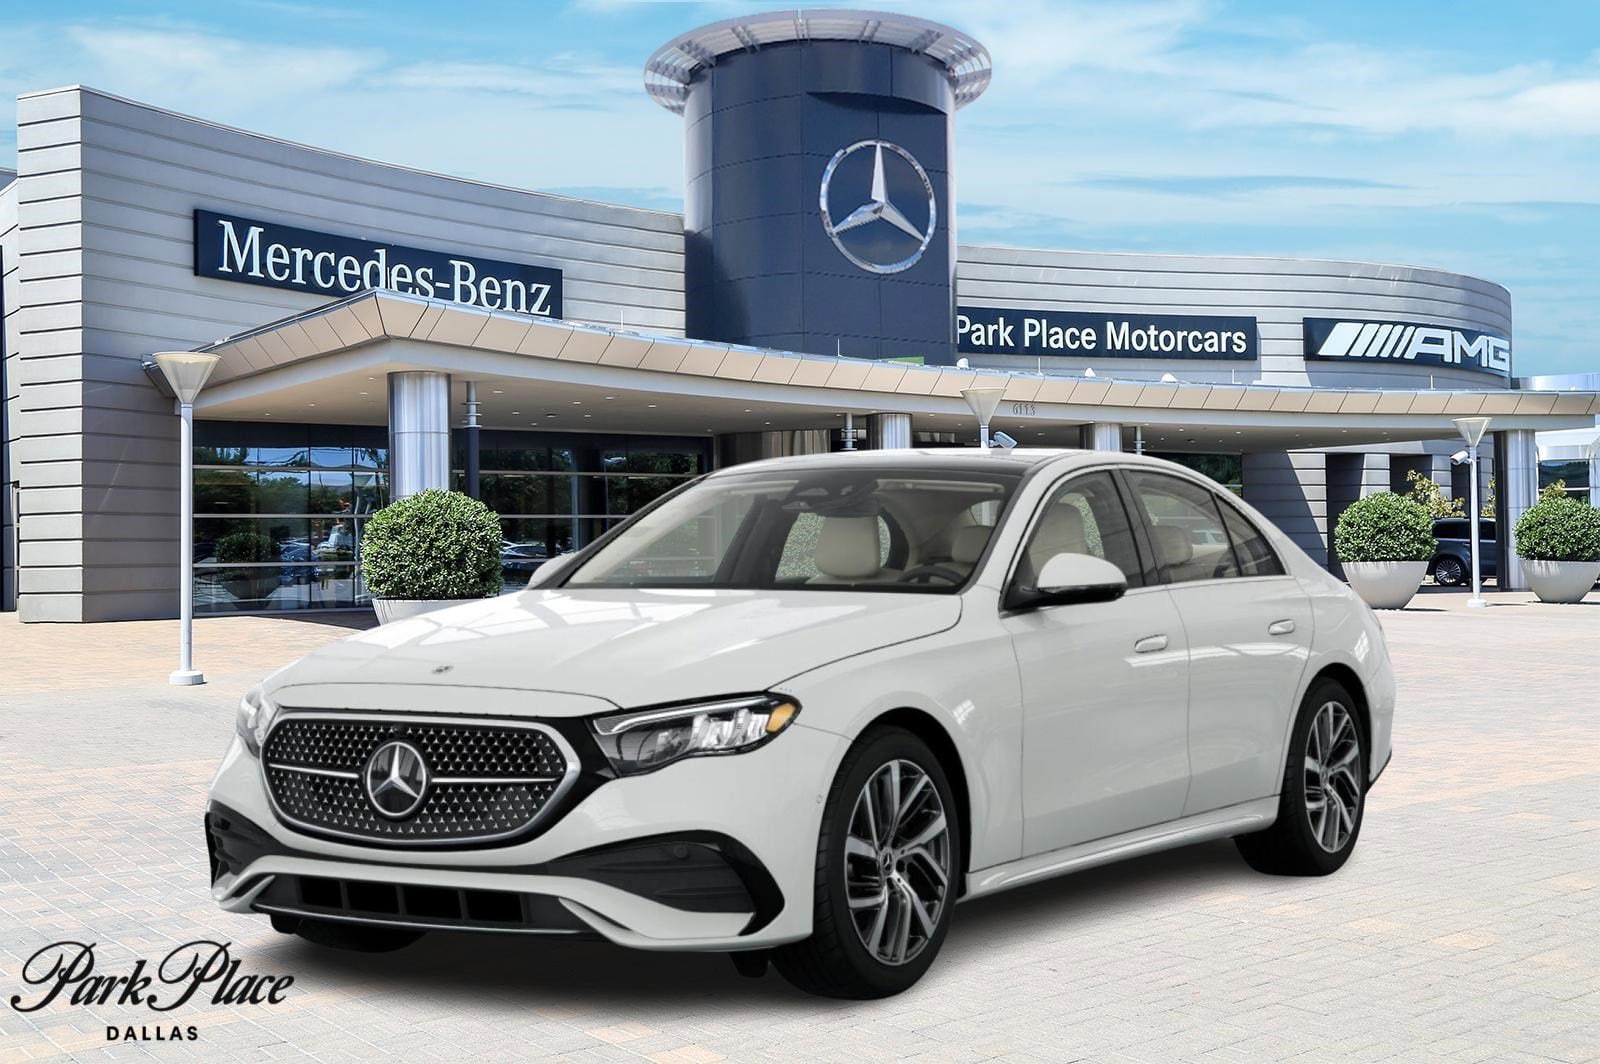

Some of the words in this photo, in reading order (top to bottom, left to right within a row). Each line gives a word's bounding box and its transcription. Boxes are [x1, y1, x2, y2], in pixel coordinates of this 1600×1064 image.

[217, 219, 552, 316] Mercedes-Benz
[956, 314, 1015, 348] Park
[1023, 318, 1098, 350] Place
[1106, 321, 1248, 354] Motorcars
[1403, 326, 1511, 372] AMG
[1012, 402, 1037, 416] 6113
